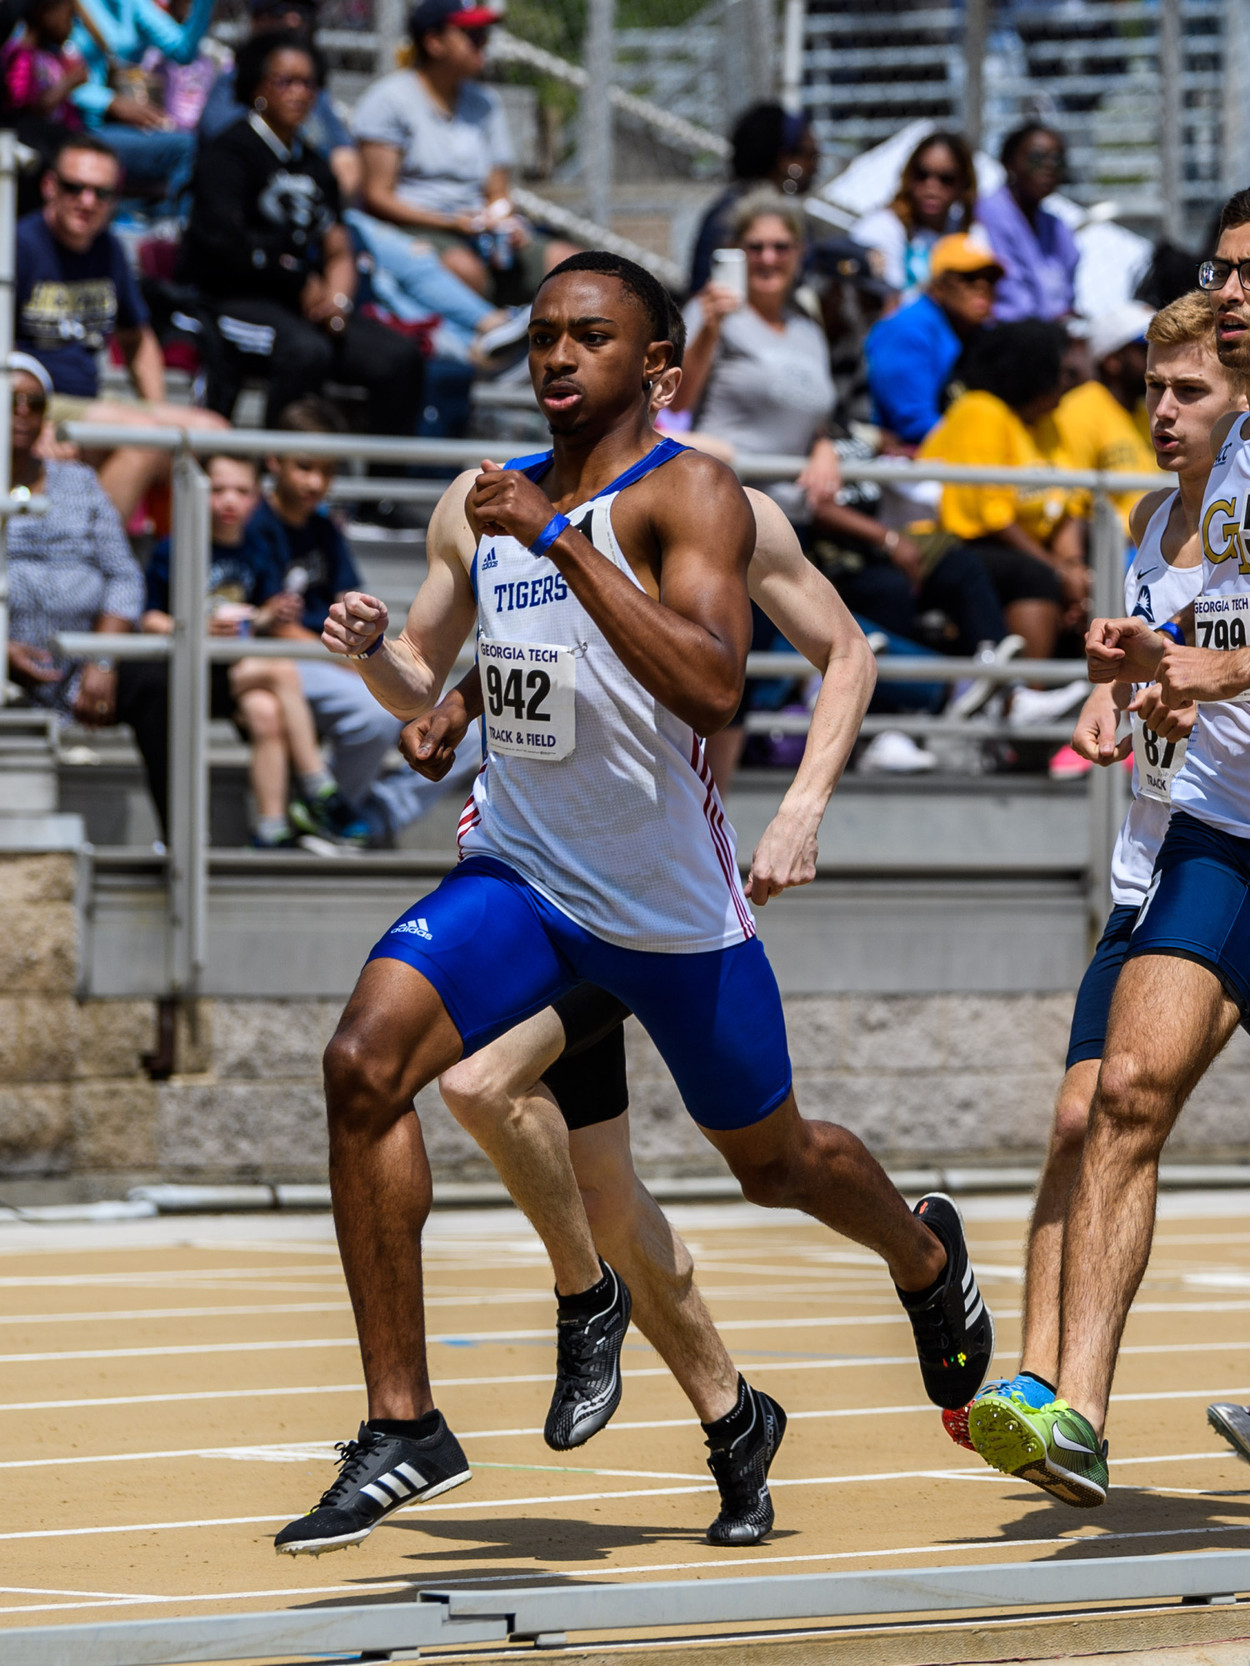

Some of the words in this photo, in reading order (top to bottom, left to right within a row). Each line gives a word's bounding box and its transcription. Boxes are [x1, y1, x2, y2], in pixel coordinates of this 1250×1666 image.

[494, 572, 568, 613] TIGERS
[1194, 600, 1230, 614] GEORGIA
[1231, 597, 1249, 611] TECH
[1196, 617, 1247, 652] 799
[480, 642, 525, 661] GEORGIA
[528, 648, 558, 663] TECH
[486, 665, 551, 722] 942
[489, 726, 513, 744] TRACK
[516, 731, 525, 744] &
[526, 732, 556, 748] FIELD
[1146, 774, 1167, 791] TRACK
[390, 925, 433, 941] adidas
